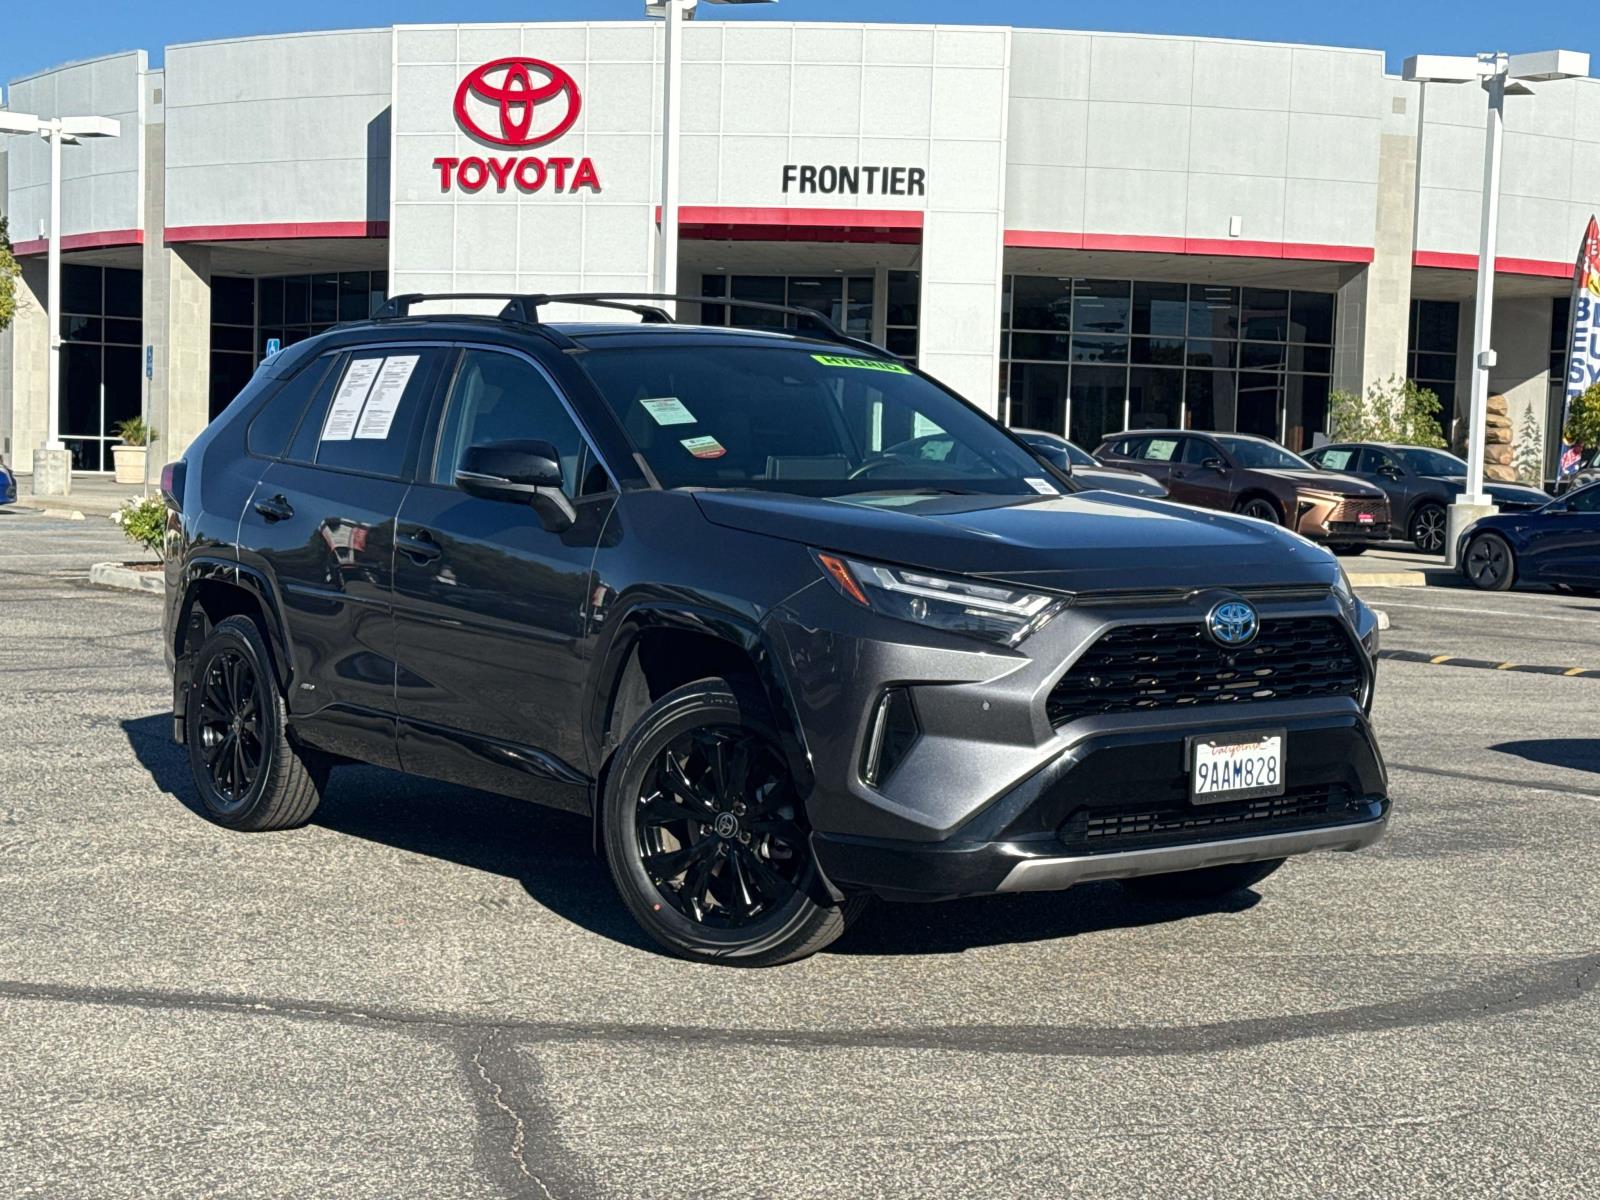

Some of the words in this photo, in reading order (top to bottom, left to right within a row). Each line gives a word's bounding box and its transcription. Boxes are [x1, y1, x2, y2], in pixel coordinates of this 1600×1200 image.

[432, 156, 602, 194] TOYOTA
[782, 164, 925, 196] FRONTIER
[821, 355, 905, 372] HYBRID
[1567, 296, 1590, 397] BES
[1198, 755, 1277, 793] 9AAM828
